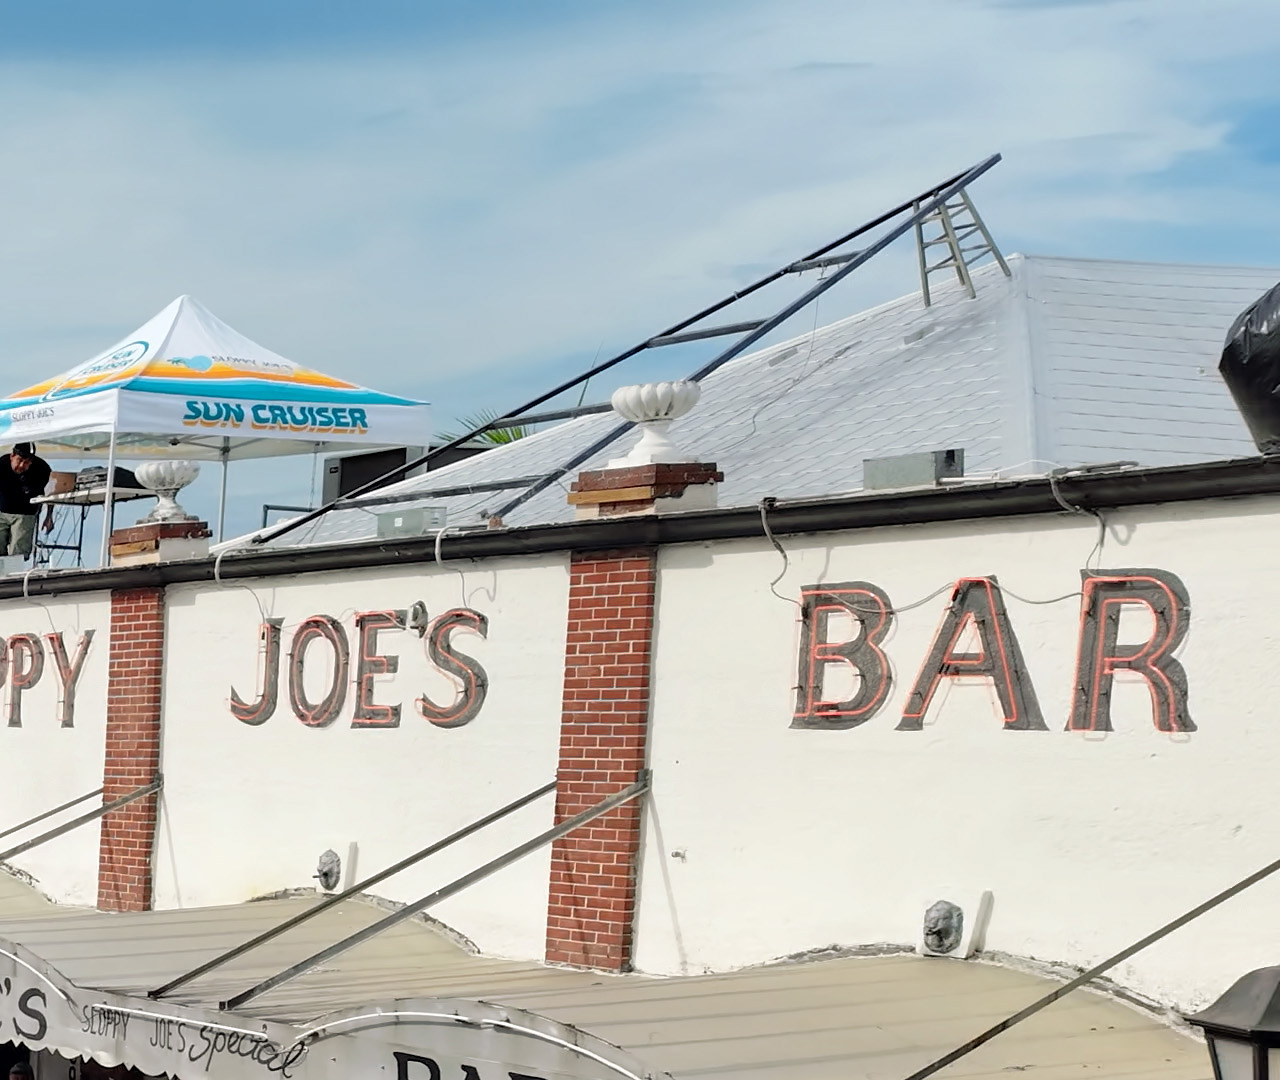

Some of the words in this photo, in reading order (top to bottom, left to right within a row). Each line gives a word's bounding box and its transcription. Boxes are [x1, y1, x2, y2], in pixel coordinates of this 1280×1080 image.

[183, 401, 244, 432] SUN
[251, 404, 369, 434] CRUISER
[229, 601, 489, 729] JOE'S
[789, 567, 1198, 732] BAR
[81, 1004, 131, 1042] SLOPPY
[149, 1016, 187, 1053] JOE'S
[188, 1023, 307, 1078] Special
